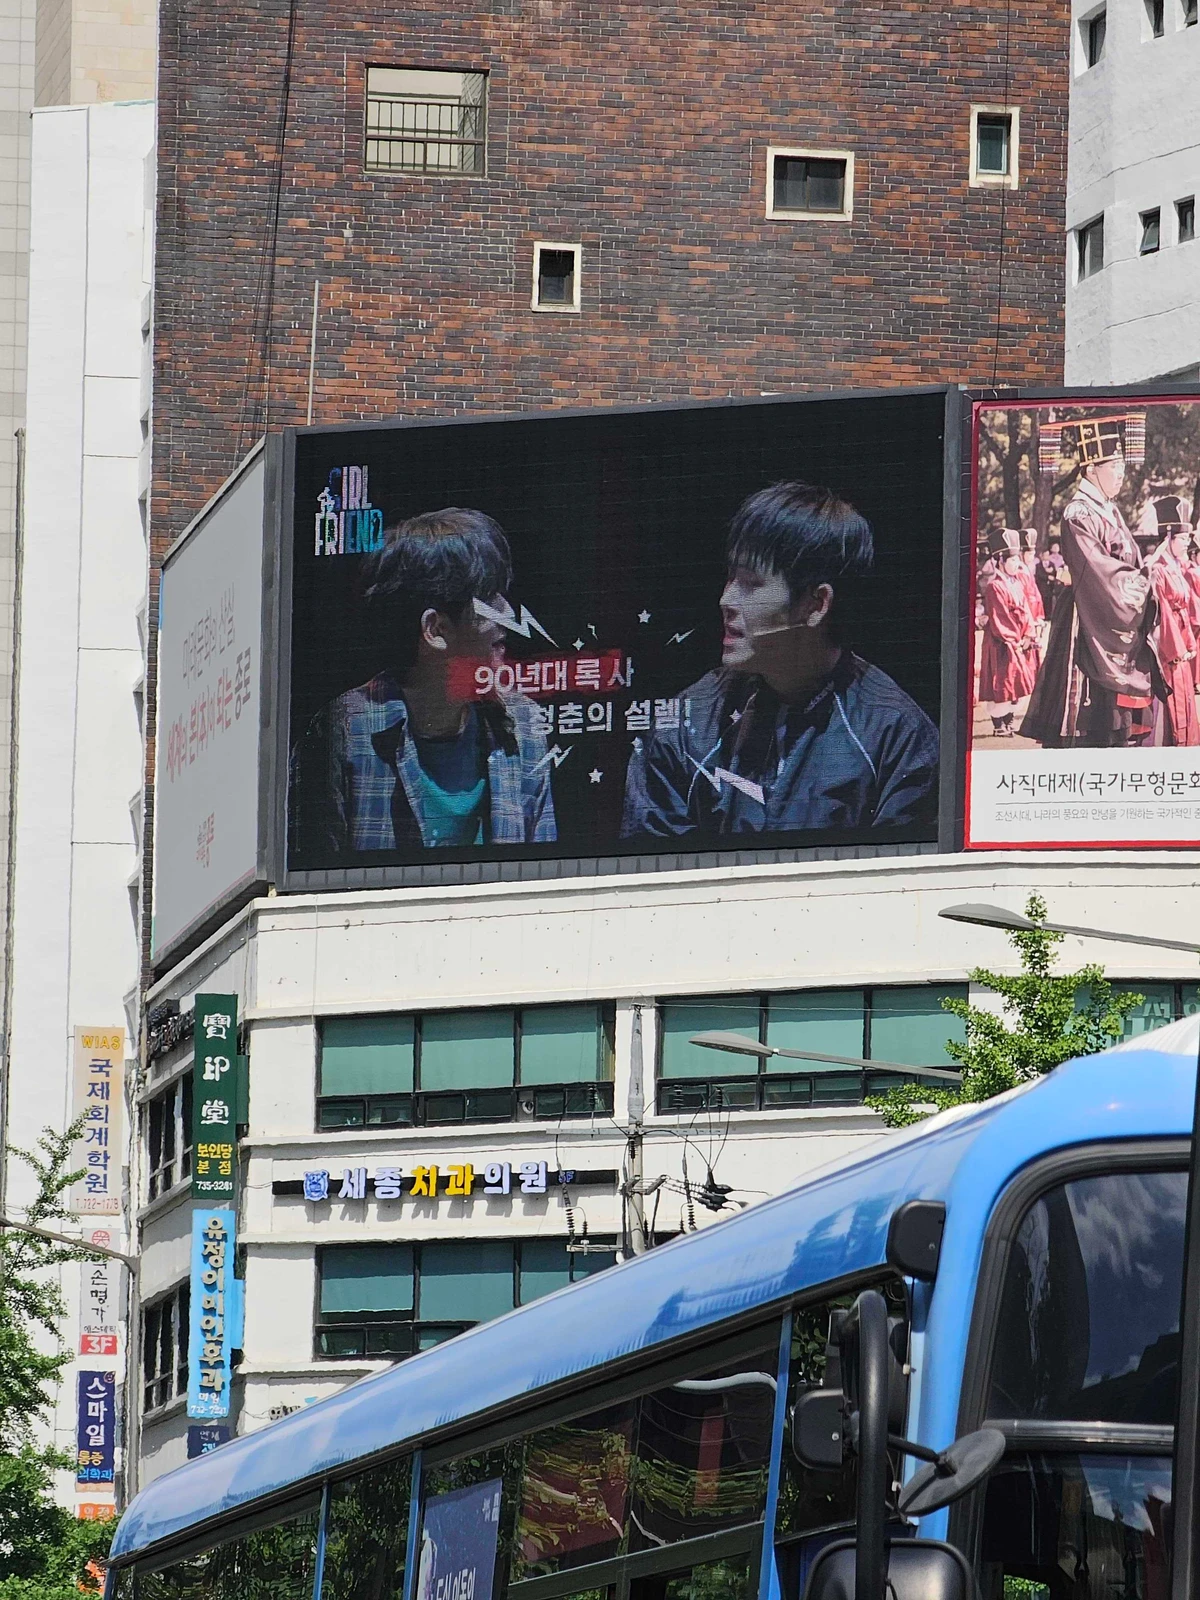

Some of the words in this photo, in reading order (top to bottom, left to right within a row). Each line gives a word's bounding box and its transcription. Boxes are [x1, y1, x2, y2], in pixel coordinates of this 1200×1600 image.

[314, 509, 384, 556] FRIEND
[235, 647, 251, 720] 종로
[474, 659, 567, 694] 90년대
[575, 658, 601, 690] 록
[607, 657, 635, 687] 사
[531, 701, 612, 735] 청춘의
[625, 698, 691, 731] 설렘!
[1034, 808, 1061, 821] 나라의
[1091, 808, 1117, 820] 안녕을
[1120, 807, 1154, 819] 기원하는
[1156, 807, 1192, 819] 국가적인
[82, 1035, 121, 1050] WIAS
[85, 1058, 113, 1194] 국제회계학원
[197, 1143, 233, 1159] 보인당
[198, 1216, 228, 1391] 유정이비인후과
[87, 1336, 112, 1354] 3F
[85, 1377, 108, 1446] 스마일
[78, 1450, 104, 1466] 통증
